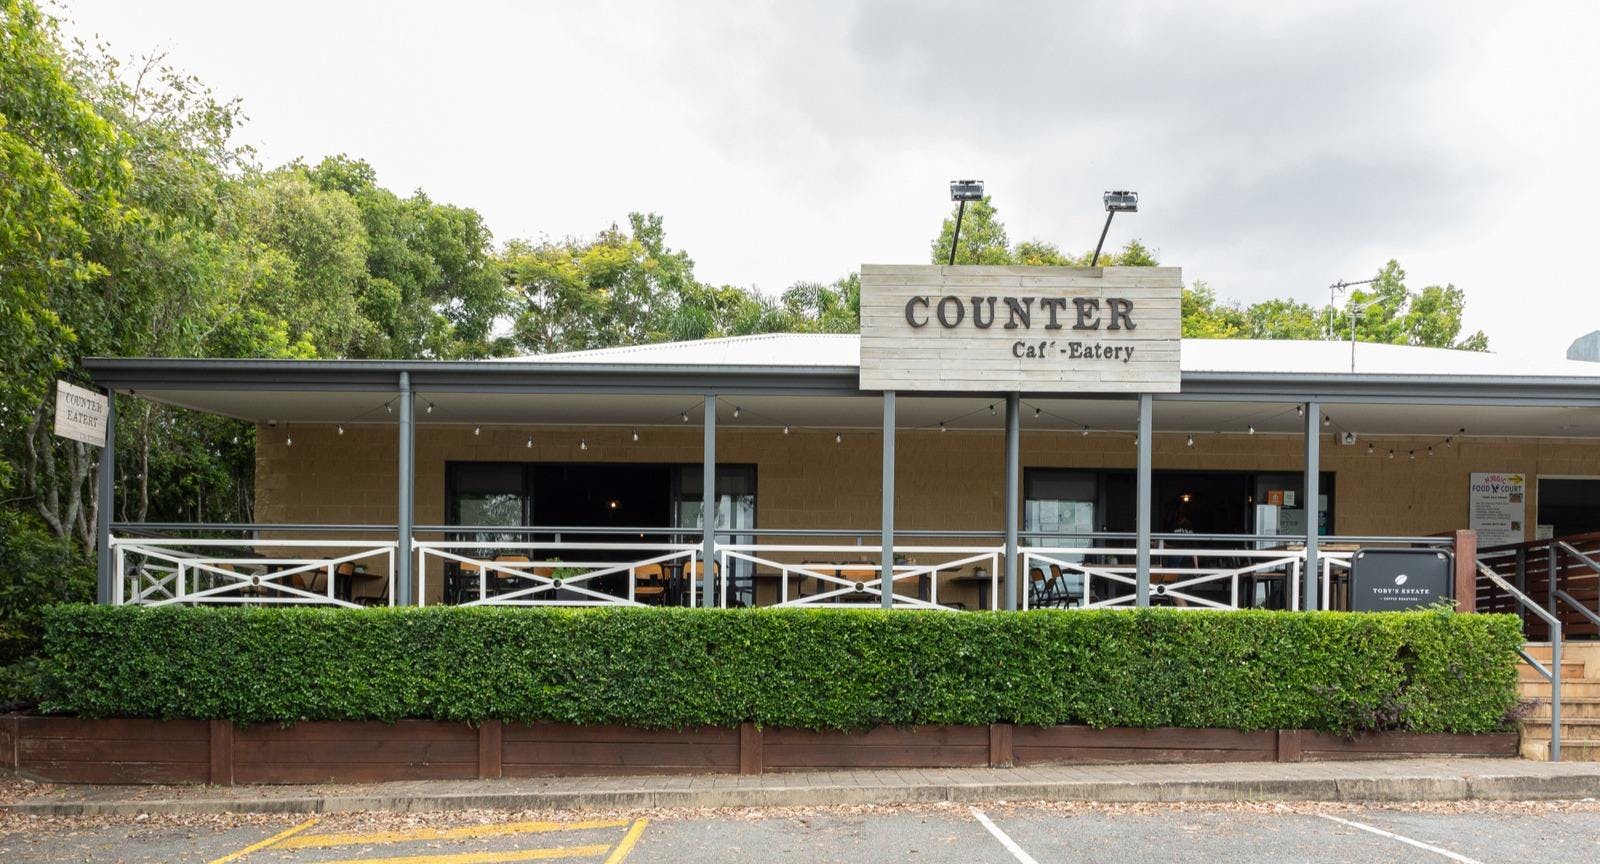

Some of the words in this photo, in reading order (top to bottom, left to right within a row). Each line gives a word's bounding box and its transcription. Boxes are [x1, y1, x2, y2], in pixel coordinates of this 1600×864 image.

[905, 295, 1137, 331] COUNTER
[66, 393, 102, 413] COUNTER
[67, 410, 97, 427] EATERY
[1472, 485, 1490, 493] FOOD
[1500, 485, 1522, 493] COURT
